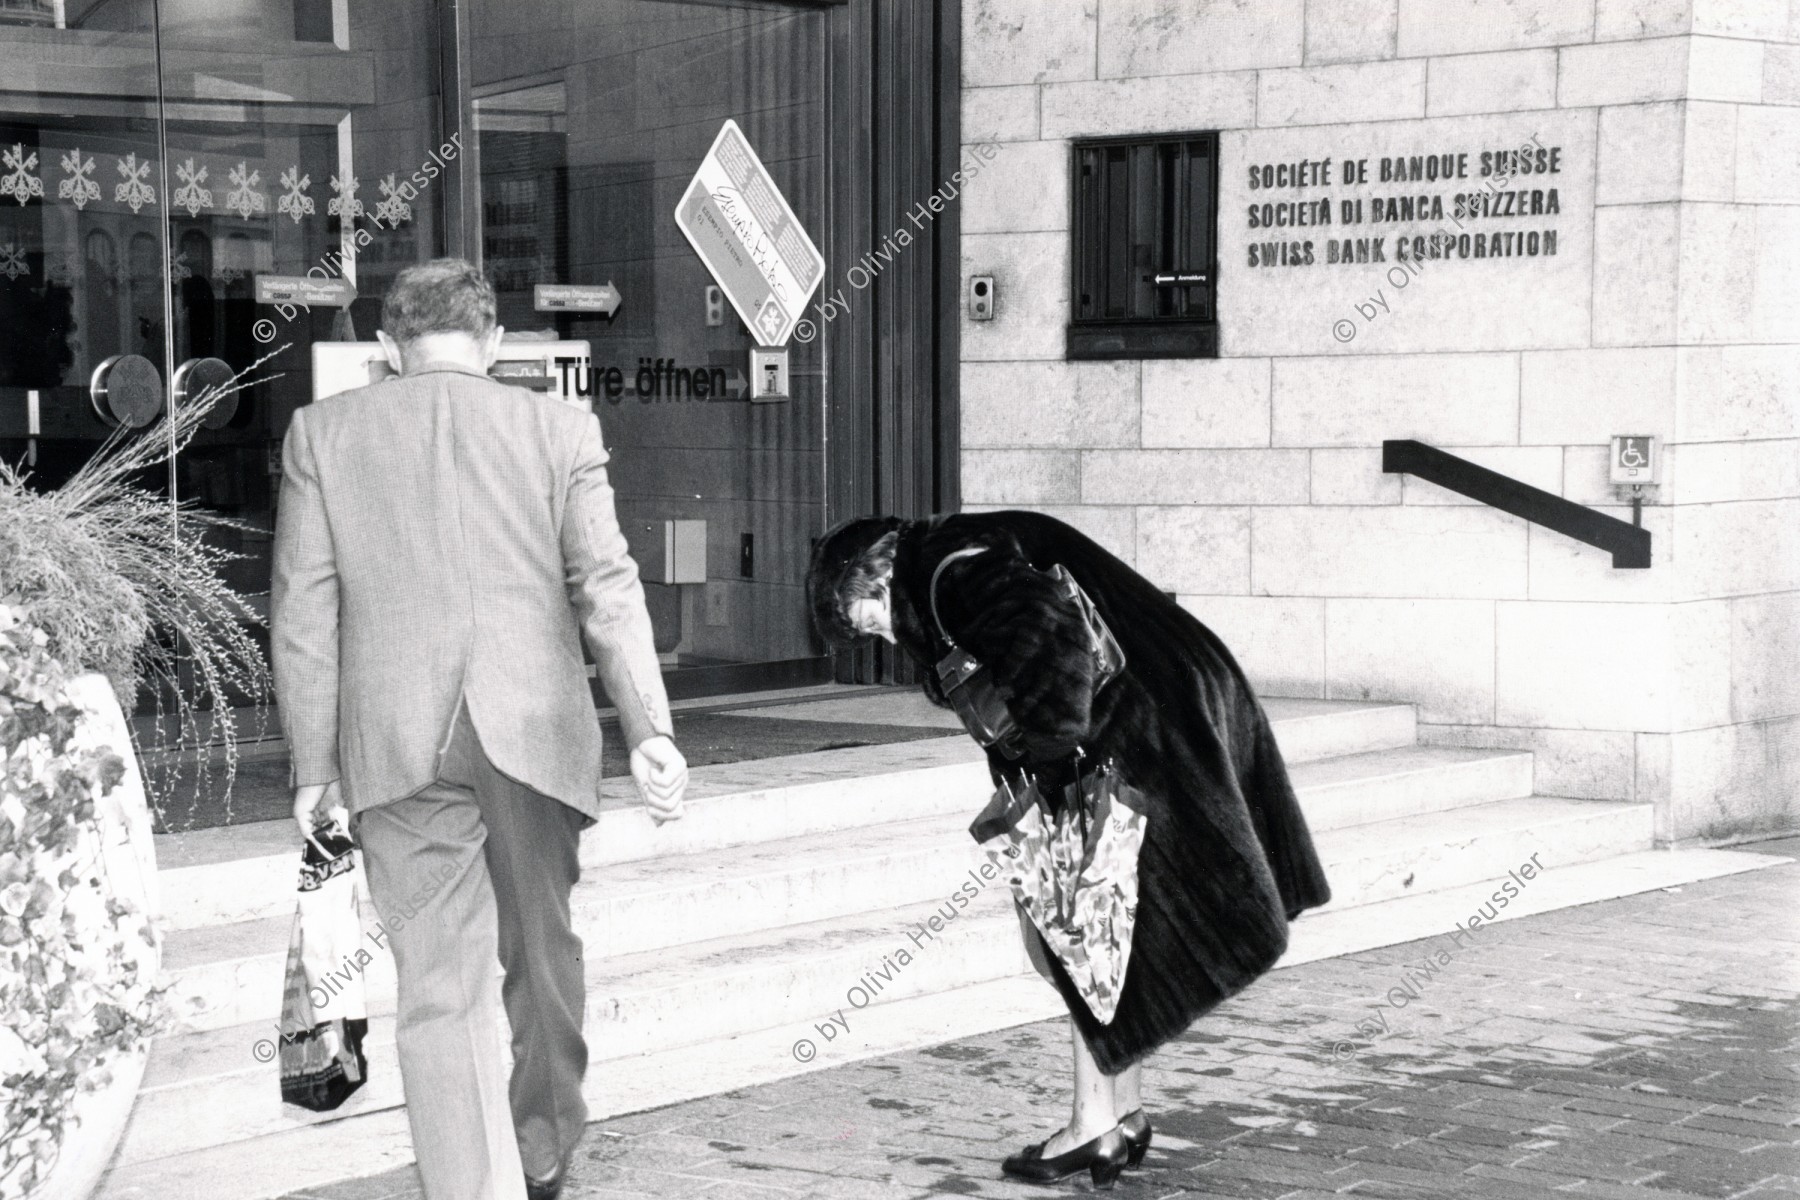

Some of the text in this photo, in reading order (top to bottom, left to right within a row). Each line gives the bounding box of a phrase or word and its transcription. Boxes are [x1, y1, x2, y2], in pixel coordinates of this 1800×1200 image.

[1249, 147, 1562, 190] SOCIÉTÉ DE BANQUE SUISSE
[1341, 199, 1363, 225] DI
[1371, 195, 1444, 223] BANCA
[1454, 188, 1560, 221] SVIZZERA
[1248, 229, 1559, 267] SWISS BANK CORPORATION
[554, 356, 727, 398] Türe öffnen
